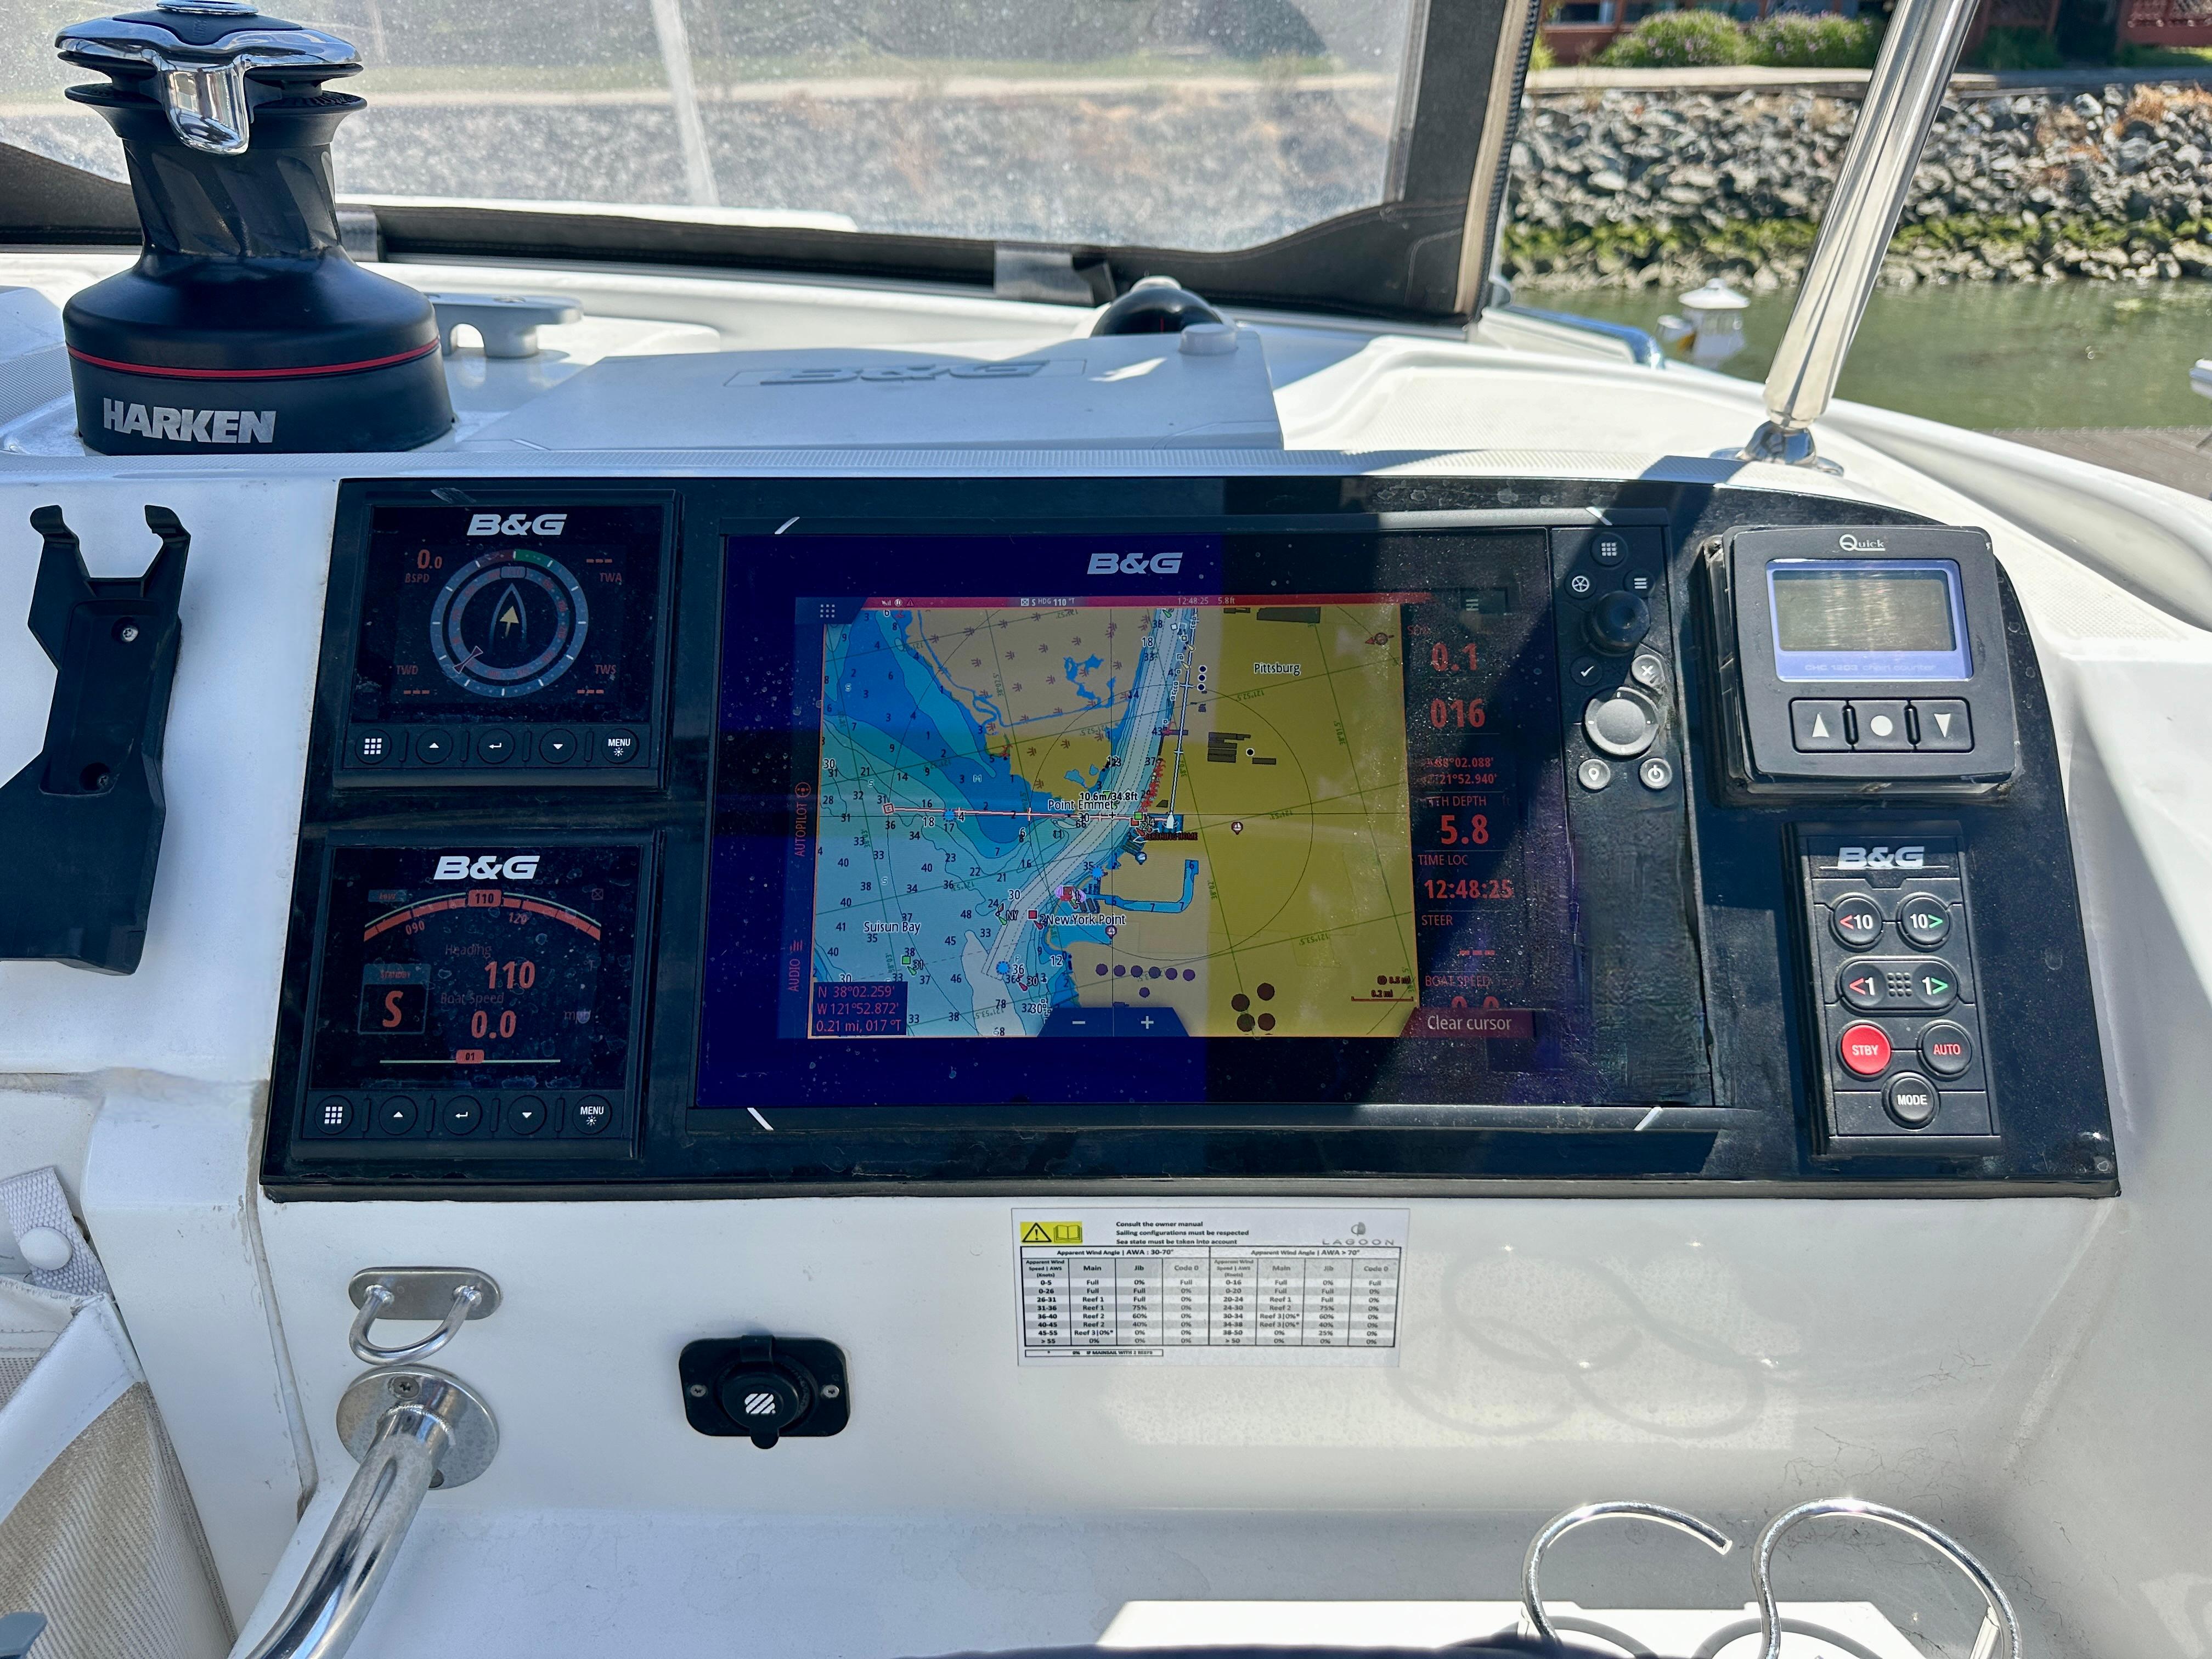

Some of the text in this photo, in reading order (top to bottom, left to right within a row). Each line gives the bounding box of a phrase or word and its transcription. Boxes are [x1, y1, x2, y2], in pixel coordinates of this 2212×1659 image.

[103, 398, 276, 443] HARKEN
[467, 514, 567, 535] B&G
[1839, 534, 1886, 551] Quick
[1087, 552, 1183, 574] B&G
[405, 573, 430, 583] BSPD
[600, 573, 622, 583] TWA
[1053, 598, 1066, 606] 110
[1142, 637, 1153, 647] 18
[1432, 642, 1477, 671] 0.1
[397, 665, 418, 675] TWD
[595, 665, 617, 675] TWS
[1254, 663, 1301, 676] Pittsburg
[1430, 698, 1485, 729] 016
[608, 738, 630, 747] MENU
[898, 773, 909, 782] 14
[853, 791, 864, 800] 32
[1453, 796, 1486, 806] DEPTH
[1048, 800, 1075, 810] Point
[795, 802, 808, 857] AUTOPILOT
[1441, 815, 1489, 845] 5.8
[910, 832, 920, 840] 34
[838, 858, 849, 867] 40
[945, 853, 956, 862] 23
[1418, 854, 1469, 866] TIME LOC
[1838, 846, 1925, 870] B&G
[433, 856, 540, 880] B&G
[922, 864, 932, 873] 40
[970, 867, 980, 877] 22
[861, 882, 871, 891] 38
[907, 884, 917, 893] 34
[1424, 879, 1514, 899] 12:48:25
[475, 893, 494, 904] 110
[1008, 890, 1020, 900] 30
[509, 912, 528, 925] 120
[961, 910, 972, 919] 48
[1047, 914, 1126, 925] New York Point
[1421, 915, 1453, 926] STEER
[405, 920, 425, 935] 090
[836, 922, 846, 932] 41
[864, 922, 921, 935] Suisun Bay
[867, 934, 878, 943] 35
[945, 936, 956, 946] 45
[445, 944, 492, 957] Heading
[485, 961, 535, 989] 110
[788, 958, 801, 992] AUDIO
[919, 975, 930, 985] 37
[951, 974, 962, 984] 46
[1425, 975, 1490, 987] BOAT SPEED
[818, 986, 827, 998] N
[441, 992, 504, 1006] Boat Speed
[382, 990, 403, 1028] S
[817, 1003, 827, 1015] W
[909, 1014, 919, 1023] 33
[949, 1013, 960, 1022] 38
[1427, 1015, 1513, 1030] Clear cursor
[471, 1010, 517, 1039] 0.0
[816, 1020, 839, 1032] 0.21
[866, 1020, 887, 1031] 017
[1852, 1045, 1878, 1056] STBY
[1933, 1044, 1961, 1055] AUTO
[1898, 1094, 1927, 1105] MODE
[580, 1106, 604, 1115] MENU
